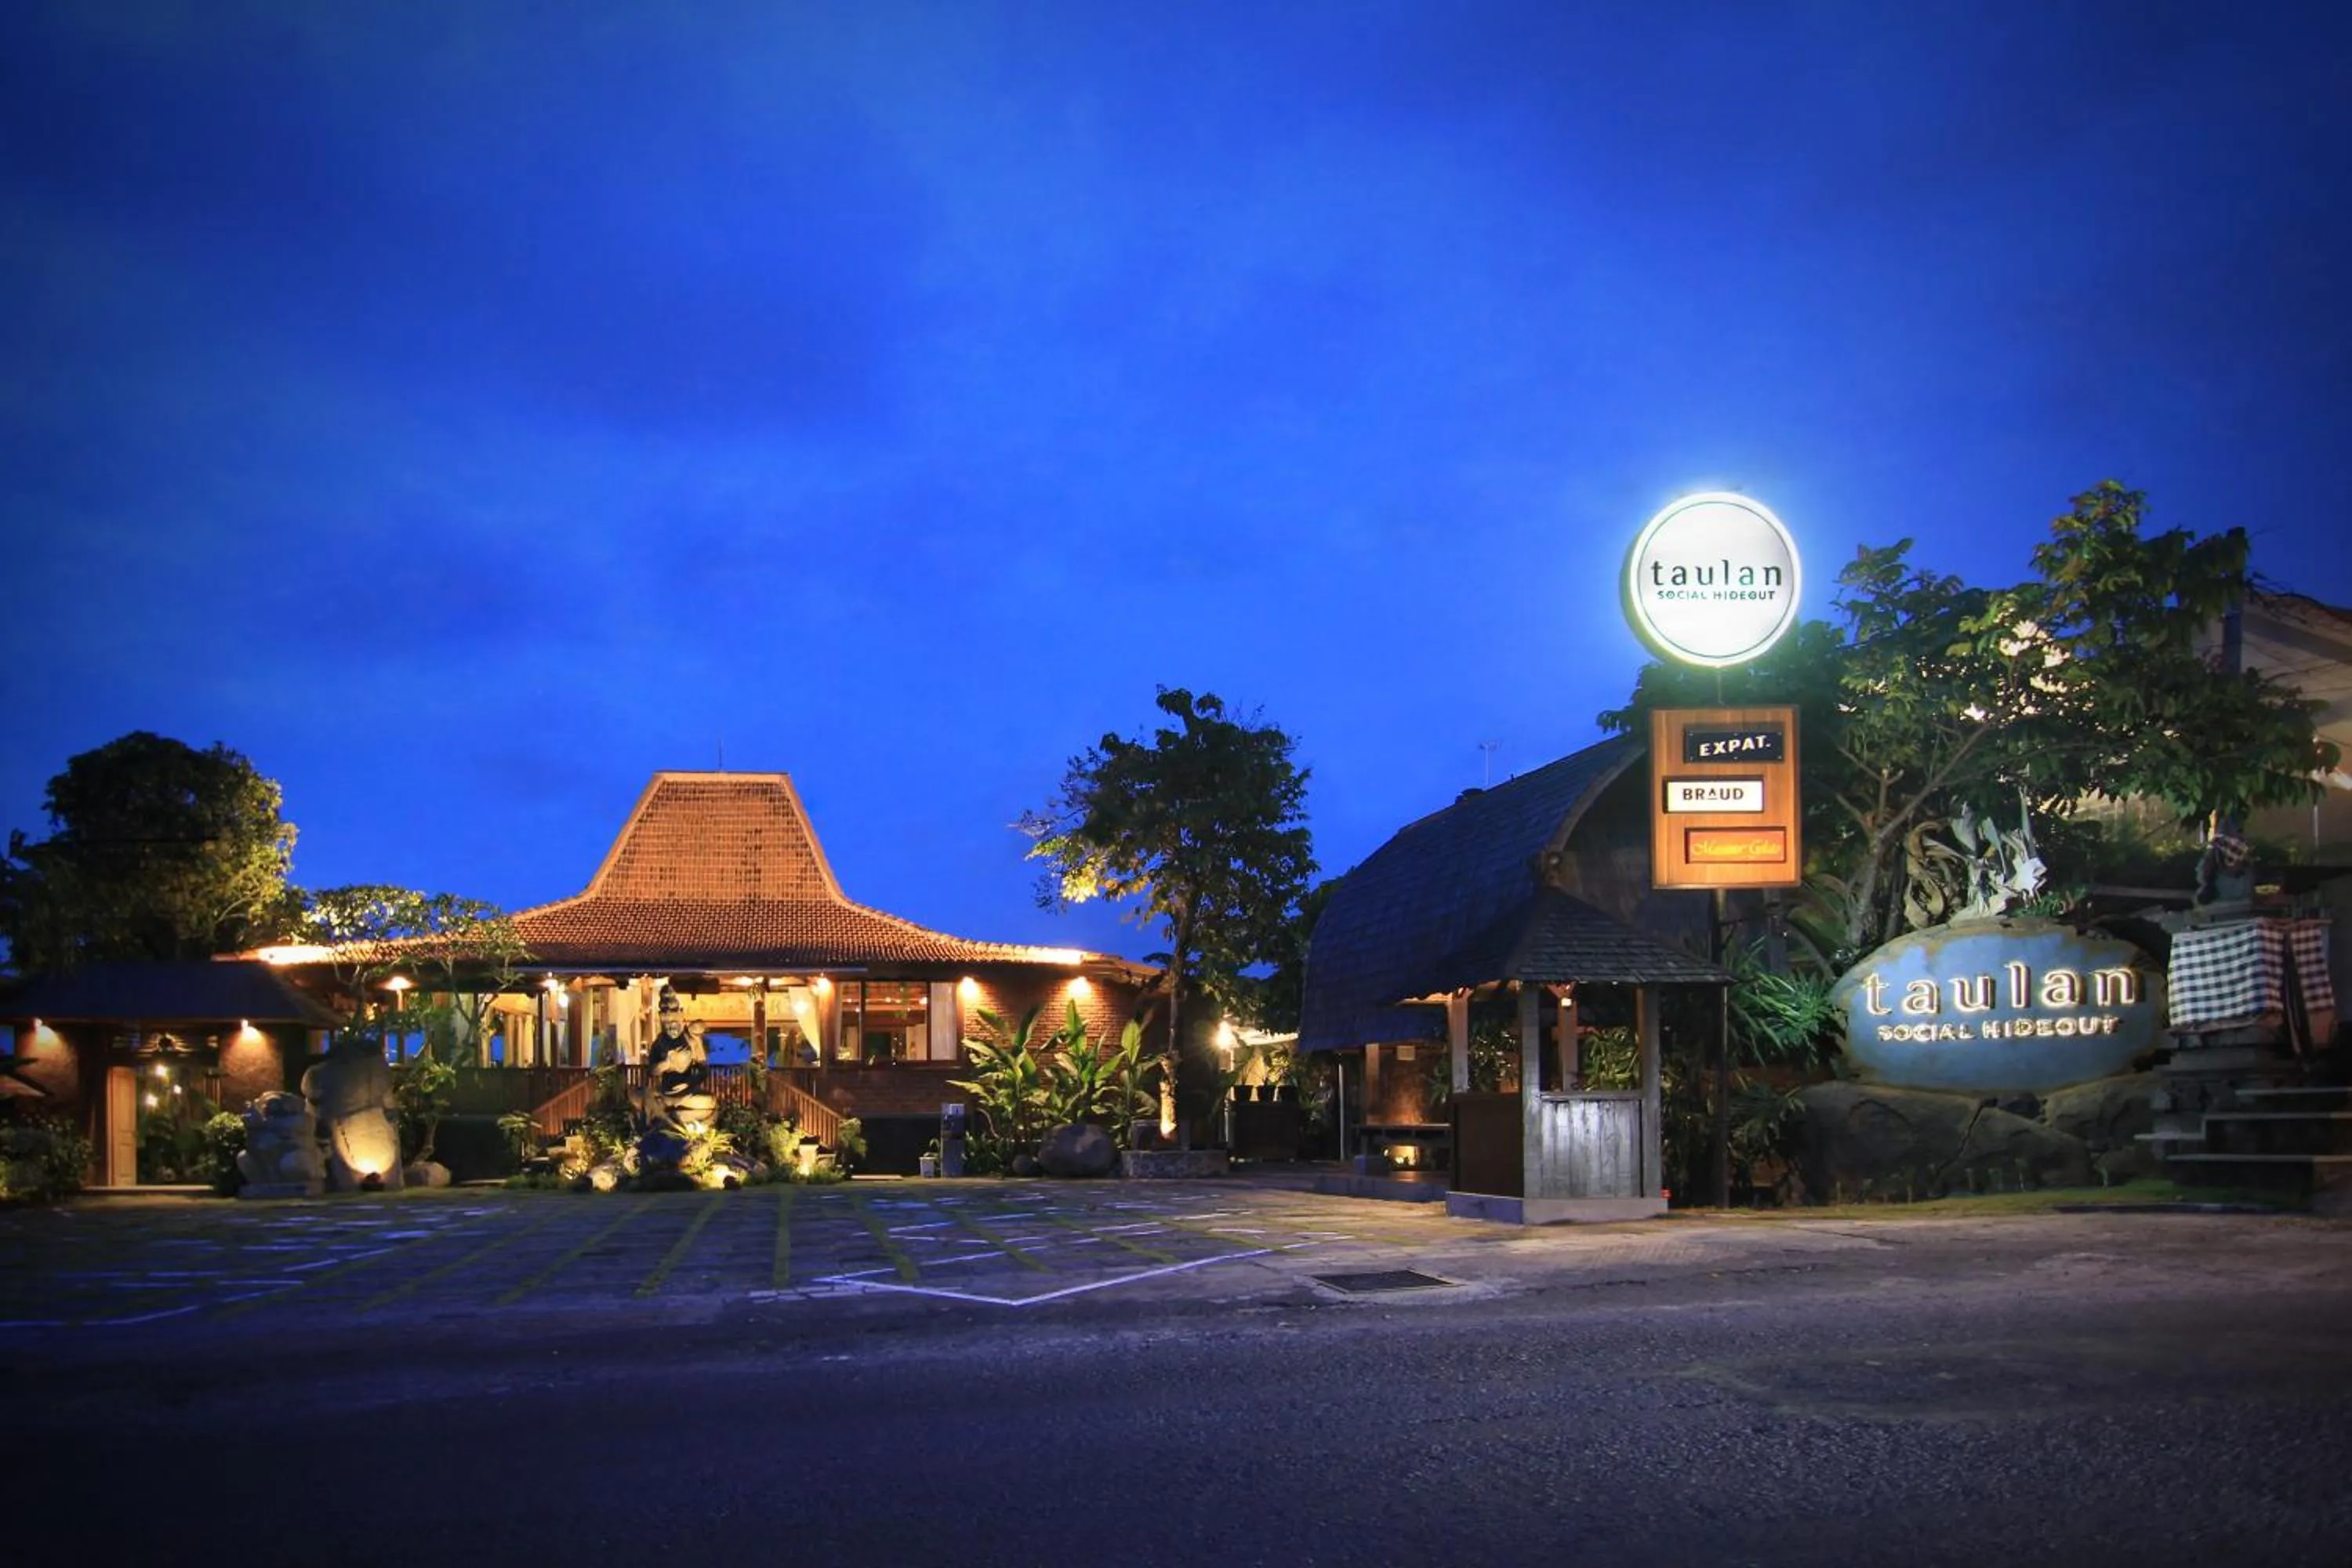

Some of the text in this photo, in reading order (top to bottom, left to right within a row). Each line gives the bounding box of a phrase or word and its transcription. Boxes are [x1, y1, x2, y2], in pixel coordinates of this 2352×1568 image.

[1650, 559, 1782, 586] taulan
[1657, 590, 1776, 600] SOCIAL HIDEOUT
[1861, 960, 2140, 1016] taulan
[1877, 1015, 2121, 1042] SOCIAL HIDEOUT
